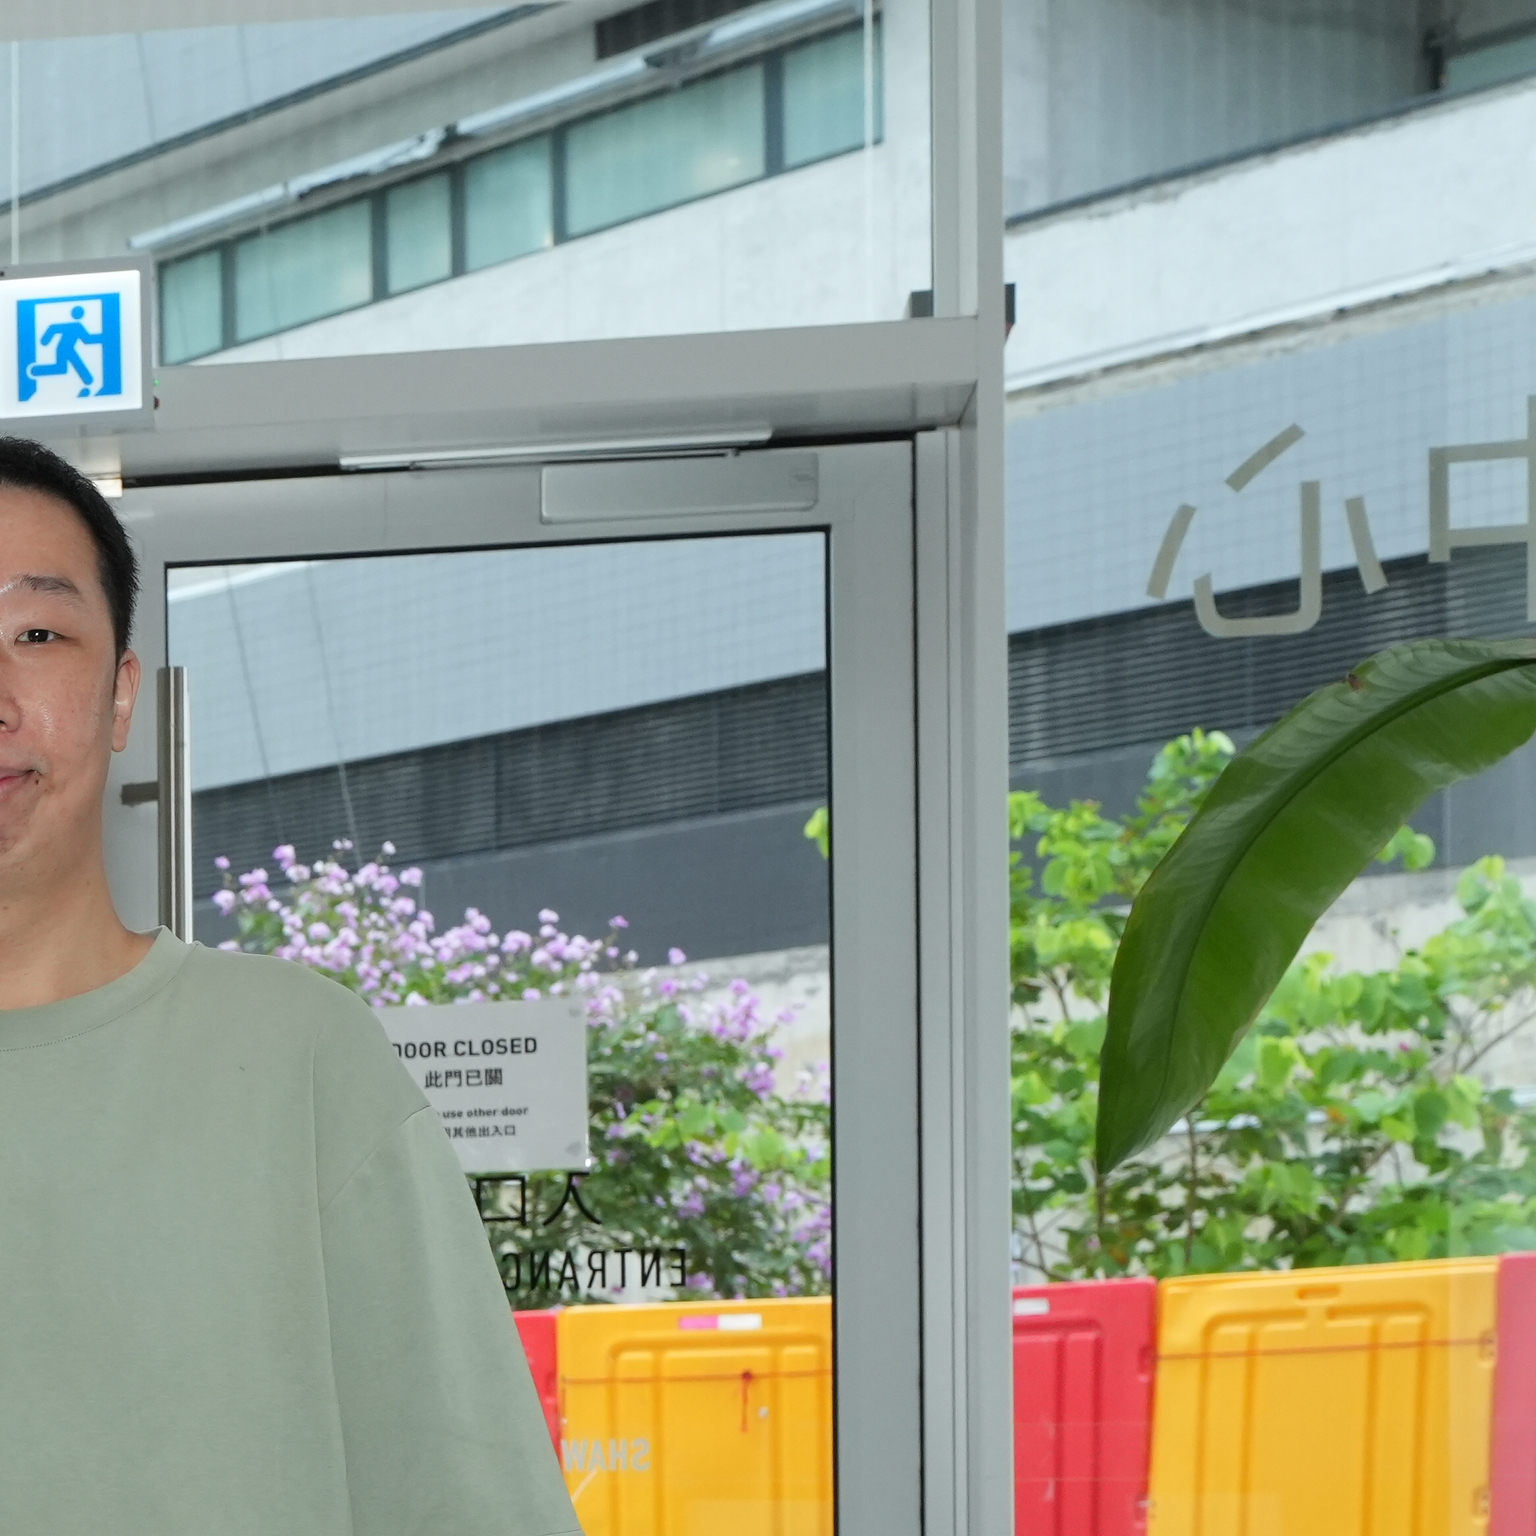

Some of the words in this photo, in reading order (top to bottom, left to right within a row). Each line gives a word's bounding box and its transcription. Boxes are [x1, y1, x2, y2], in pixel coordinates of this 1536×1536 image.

[454, 1037, 537, 1056] CLOSED
[425, 1068, 503, 1088] 此門已關
[467, 1107, 497, 1117] other
[501, 1106, 528, 1117] door
